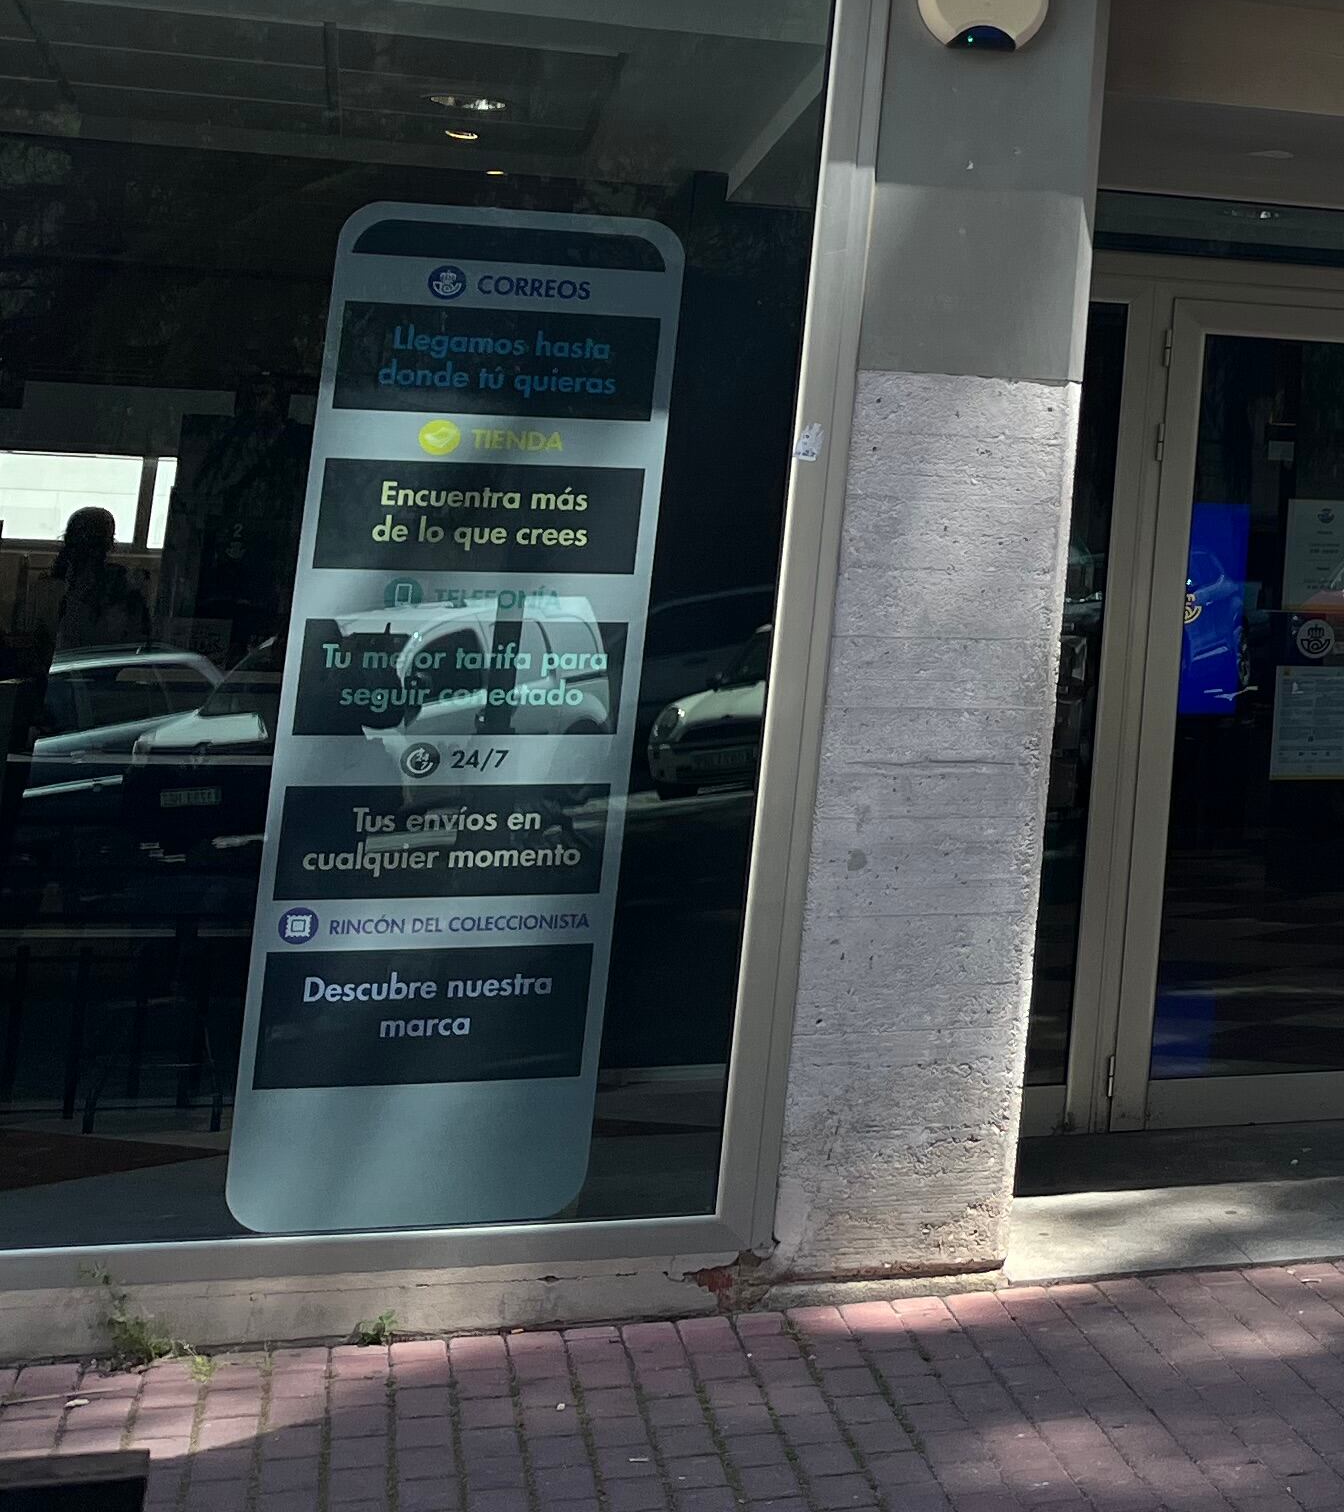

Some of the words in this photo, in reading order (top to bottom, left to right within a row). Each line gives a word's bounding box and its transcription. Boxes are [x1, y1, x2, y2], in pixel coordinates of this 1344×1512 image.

[477, 274, 592, 301] CORREOS
[392, 325, 527, 360] Llegamos
[535, 330, 611, 361] hasta
[378, 361, 470, 389] donde
[479, 366, 504, 389] tú
[514, 368, 617, 399] quieras
[471, 428, 564, 452] TIENDA
[380, 480, 521, 509] Encuentra
[530, 487, 588, 512] más
[372, 516, 409, 543] de
[418, 517, 446, 543] lo
[453, 524, 507, 551] que
[515, 525, 588, 547] crees
[322, 643, 351, 669] Tu
[456, 642, 531, 670] tarifa
[541, 652, 609, 677] para
[339, 686, 430, 713] seguir
[439, 679, 584, 706] conectado
[451, 748, 509, 772] 24/7
[352, 807, 396, 833] Tus
[406, 805, 498, 833] envíos
[507, 810, 542, 831] en
[302, 841, 440, 877] cualquier
[448, 844, 581, 869] momento
[329, 913, 407, 935] RINCÓN
[412, 916, 443, 933] DEL
[448, 913, 590, 933] COLECCIONISTA
[303, 972, 438, 1004] Descubre
[447, 973, 553, 999] nuestra
[379, 1015, 472, 1039] marca
